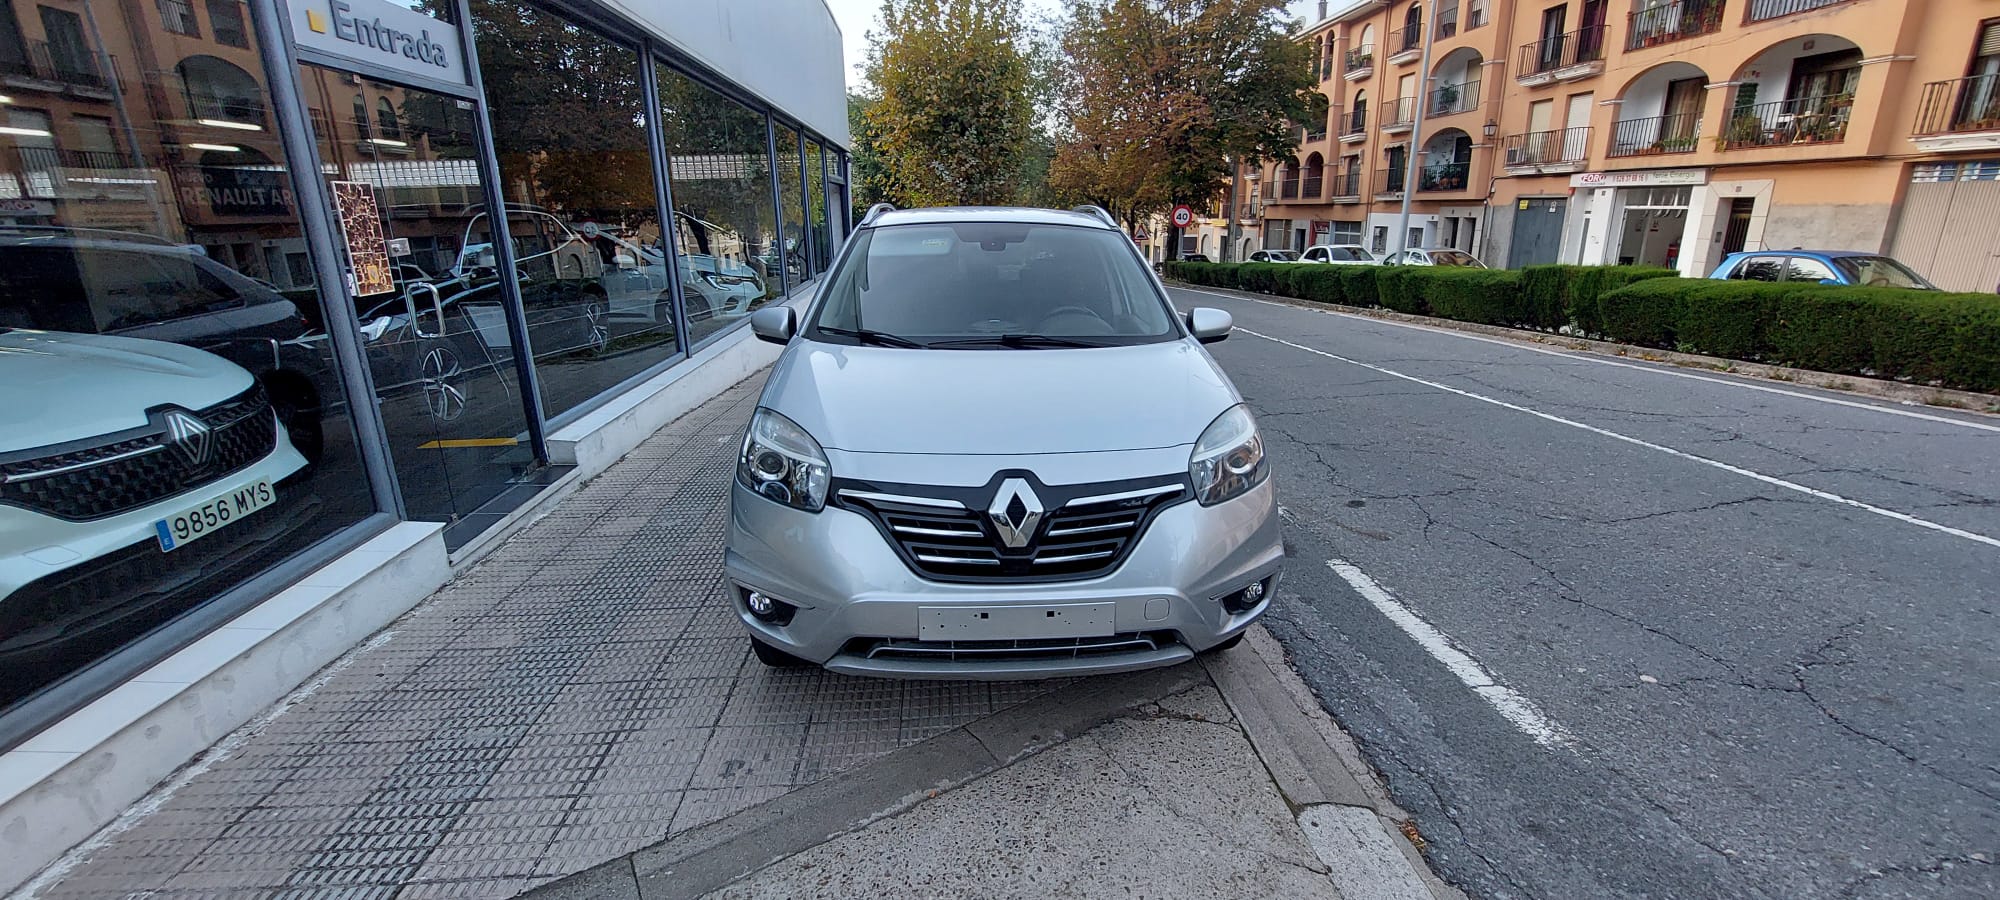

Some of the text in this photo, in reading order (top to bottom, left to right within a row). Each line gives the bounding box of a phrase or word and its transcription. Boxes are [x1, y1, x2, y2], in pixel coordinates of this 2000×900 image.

[330, 0, 449, 68] Entrada
[181, 186, 265, 207] RENAULT
[174, 482, 270, 540] 9856 MYS
[164, 537, 171, 545] E
